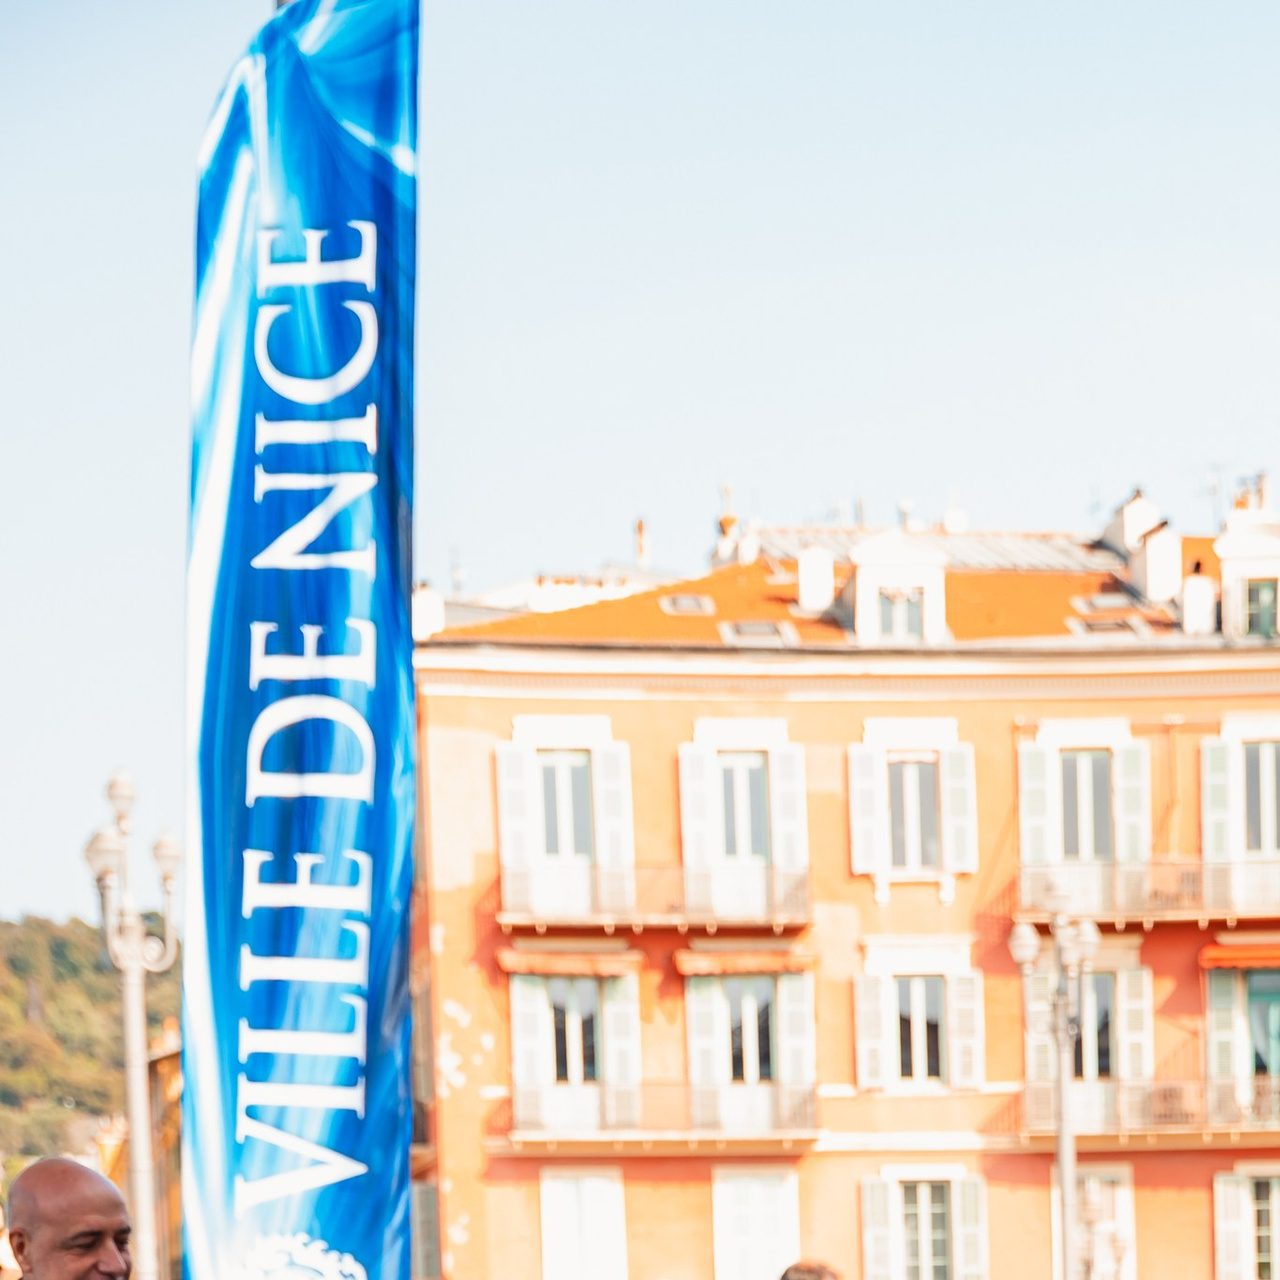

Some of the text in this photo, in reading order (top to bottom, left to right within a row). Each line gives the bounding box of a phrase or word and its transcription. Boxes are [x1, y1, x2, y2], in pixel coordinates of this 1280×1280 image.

[234, 219, 379, 1216] VILLE DE NICE
